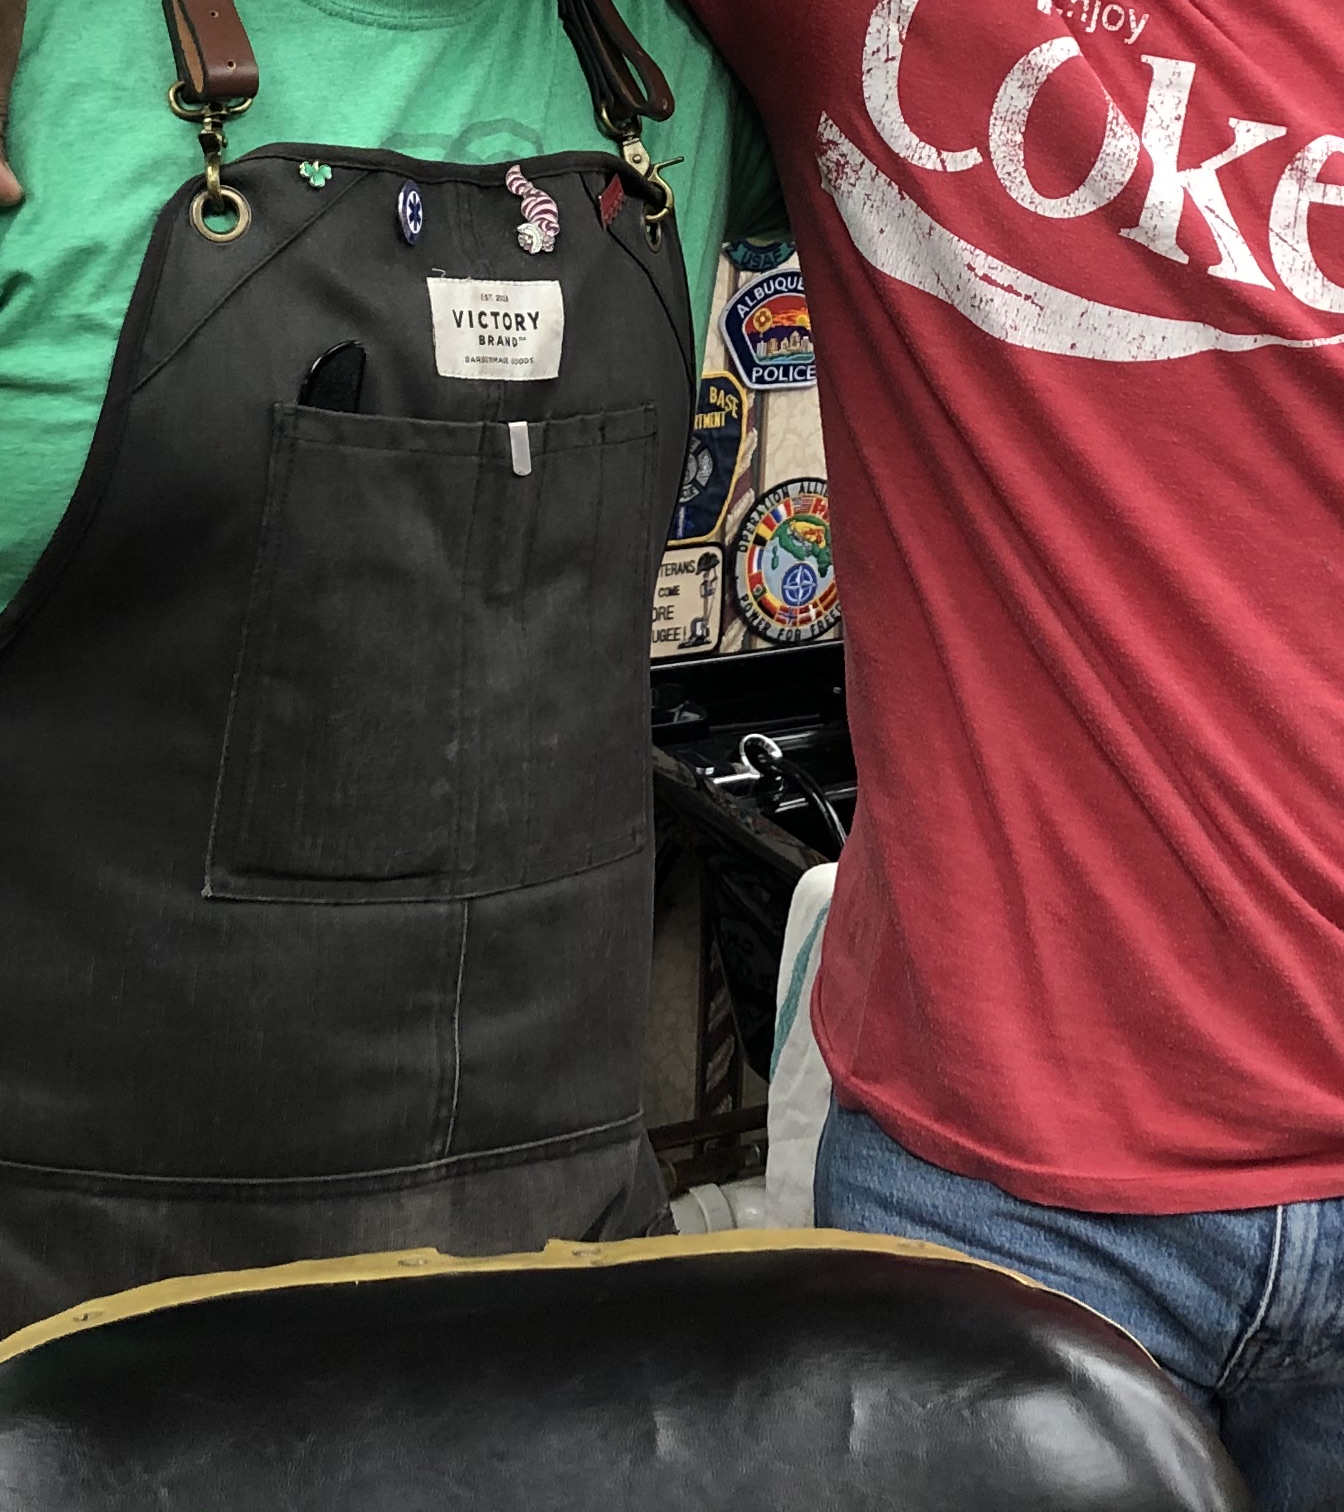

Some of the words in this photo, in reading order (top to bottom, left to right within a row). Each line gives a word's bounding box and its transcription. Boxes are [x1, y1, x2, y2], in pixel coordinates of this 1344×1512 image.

[452, 309, 540, 331] VICTORY
[752, 365, 817, 383] POLICE
[709, 386, 740, 419] BASE
[738, 486, 790, 553] OPERATION
[739, 594, 771, 632] POWER
[777, 629, 802, 641] FOR
